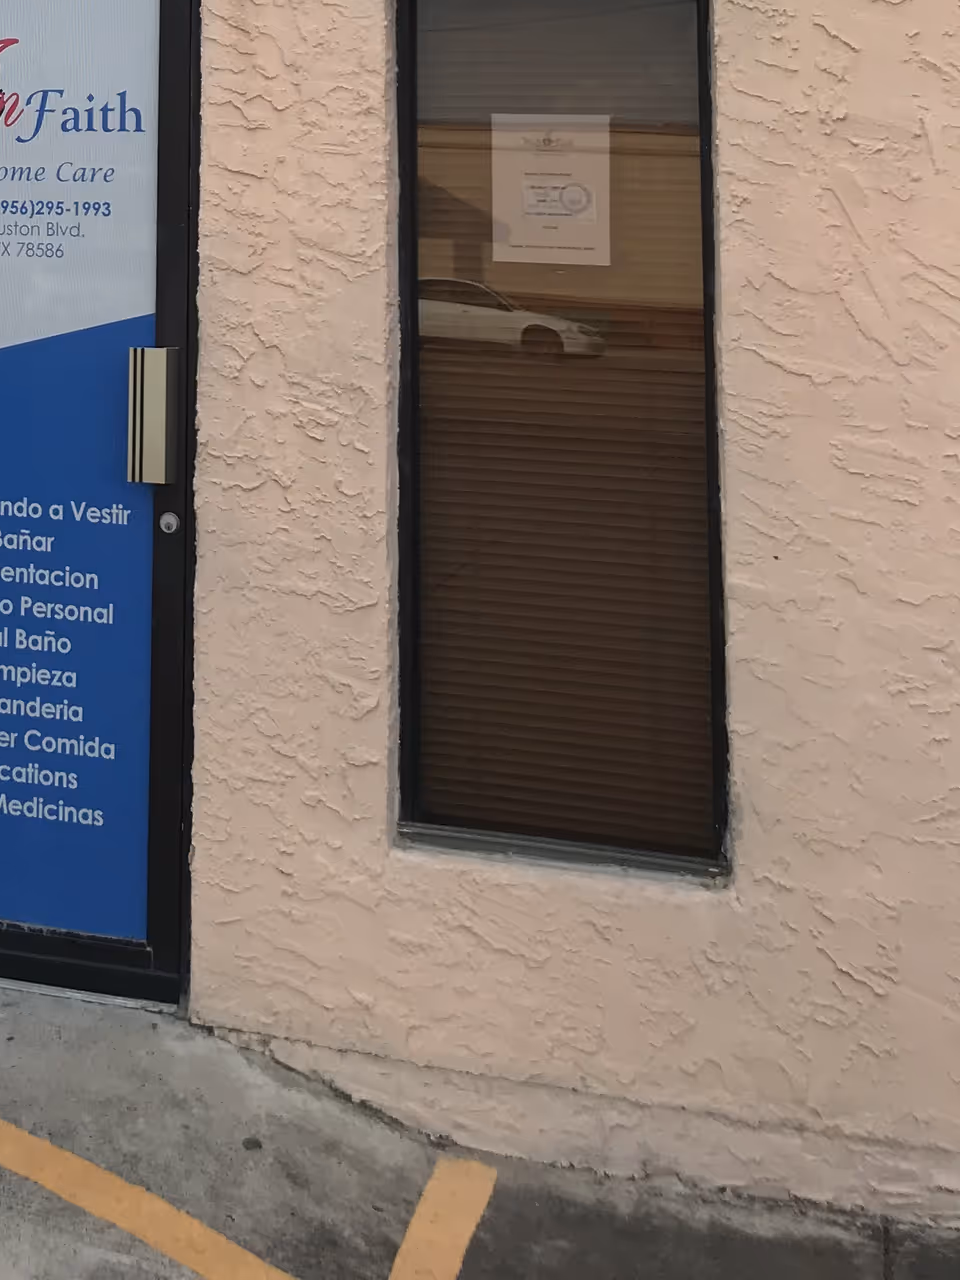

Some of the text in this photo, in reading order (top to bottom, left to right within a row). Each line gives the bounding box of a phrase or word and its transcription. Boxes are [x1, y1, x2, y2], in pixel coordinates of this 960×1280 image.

[15, 89, 146, 143] Faith
[56, 161, 115, 184] Care
[46, 221, 86, 238] Blvd.
[16, 242, 65, 259] 78586
[48, 504, 64, 521] a
[70, 500, 132, 525] Vestir
[20, 596, 114, 625] Personal
[15, 629, 72, 654] Baño
[23, 730, 115, 760] Comida
